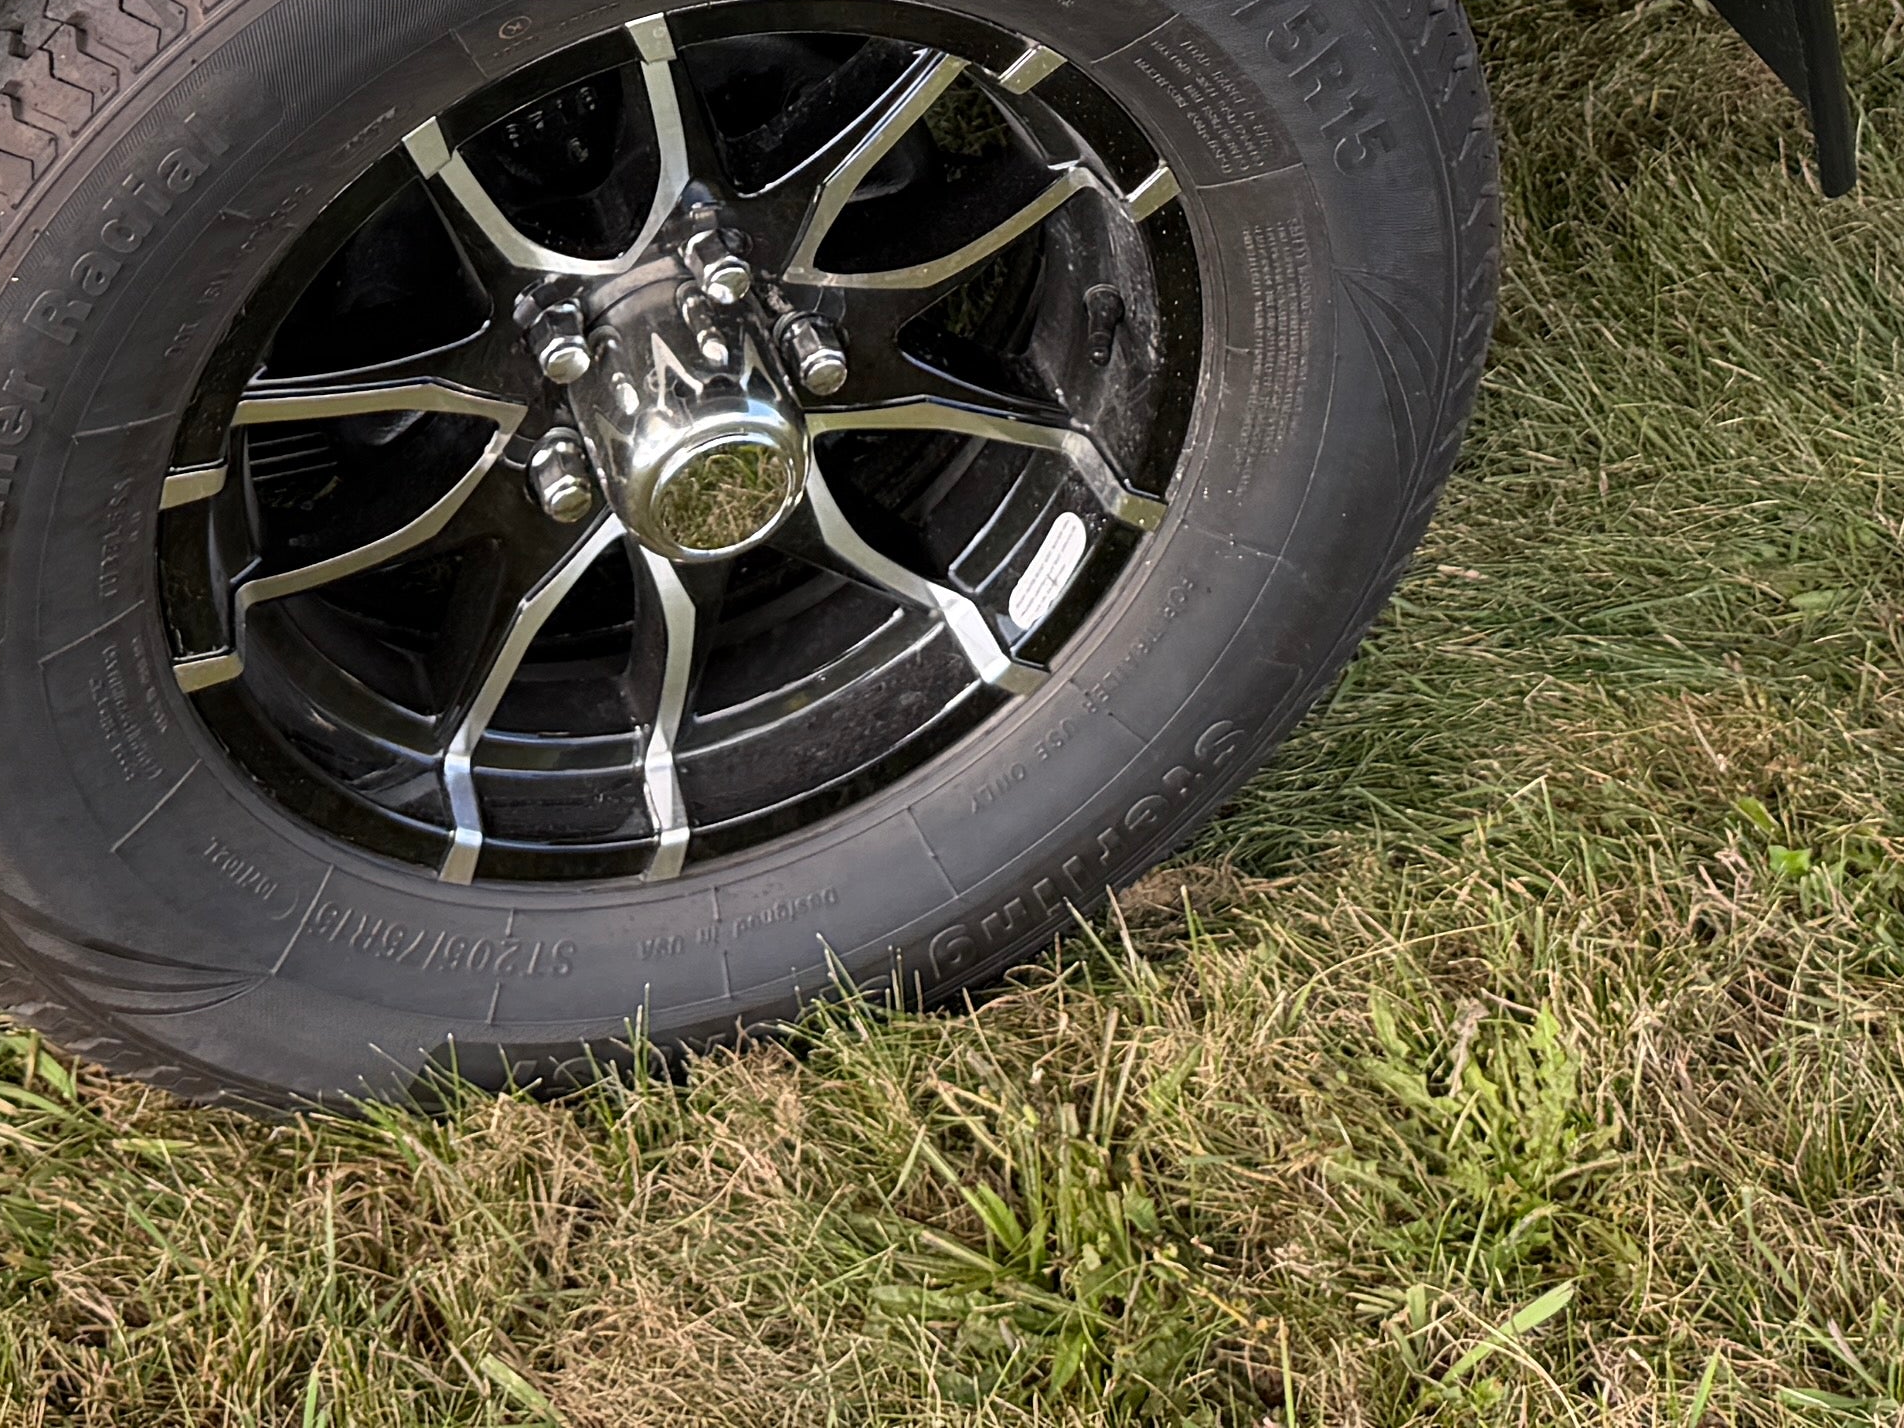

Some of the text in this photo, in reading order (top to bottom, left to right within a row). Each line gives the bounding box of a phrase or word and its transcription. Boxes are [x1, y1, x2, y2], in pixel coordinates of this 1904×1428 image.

[22, 111, 231, 346] Radial
[1162, 576, 1195, 619] FOR
[1082, 630, 1163, 714] TRAILER
[1033, 717, 1077, 761] USE
[928, 718, 1247, 979] Sterling
[307, 899, 577, 976] ST205/75R15
[731, 885, 840, 939] Designed
